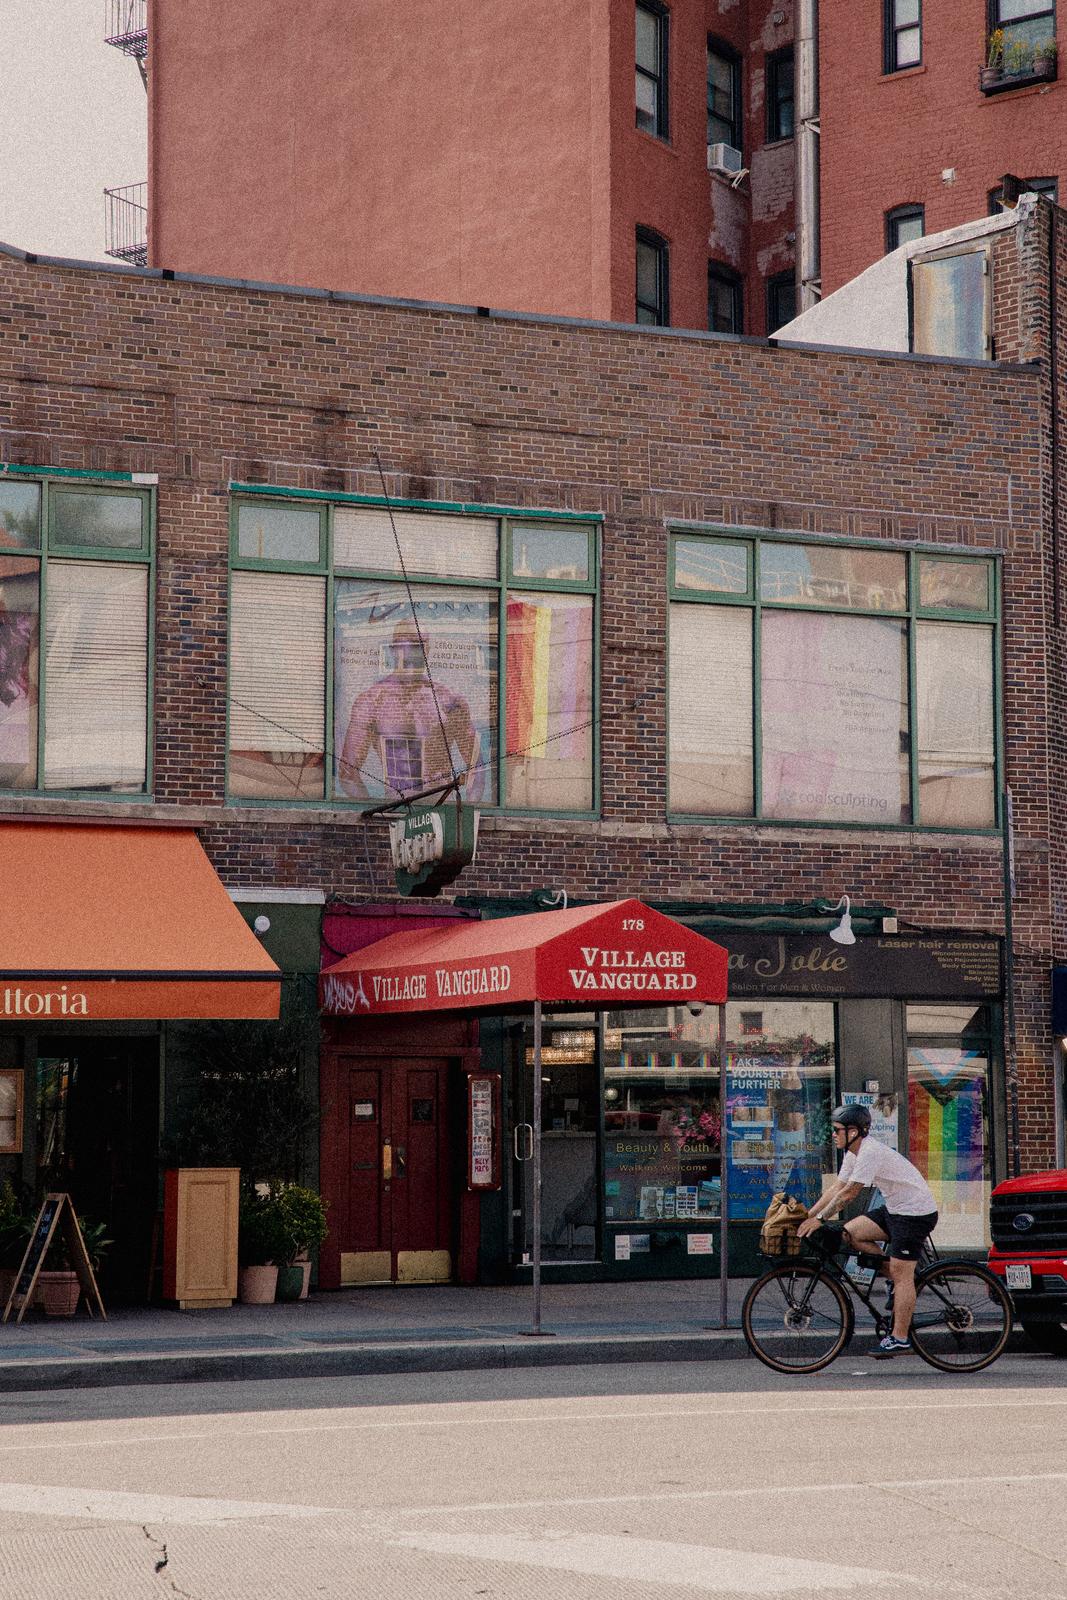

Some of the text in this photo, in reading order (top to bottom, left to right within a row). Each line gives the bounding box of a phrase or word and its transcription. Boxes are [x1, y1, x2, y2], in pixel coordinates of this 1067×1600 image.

[408, 812, 434, 830] VILLAG
[622, 919, 645, 931] 178
[878, 940, 999, 950] Laser hair removal
[580, 947, 686, 968] VILLAGE
[372, 974, 428, 1002] VILLAGE
[435, 965, 512, 997] VANGUARD
[568, 969, 698, 990] VANGUARD
[0, 985, 89, 1015] ttoria
[732, 1068, 787, 1080] YOURSELF
[732, 1079, 781, 1090] FURTHER
[844, 1096, 874, 1104] WE ARE
[616, 1142, 710, 1155] Beauty & Youth
